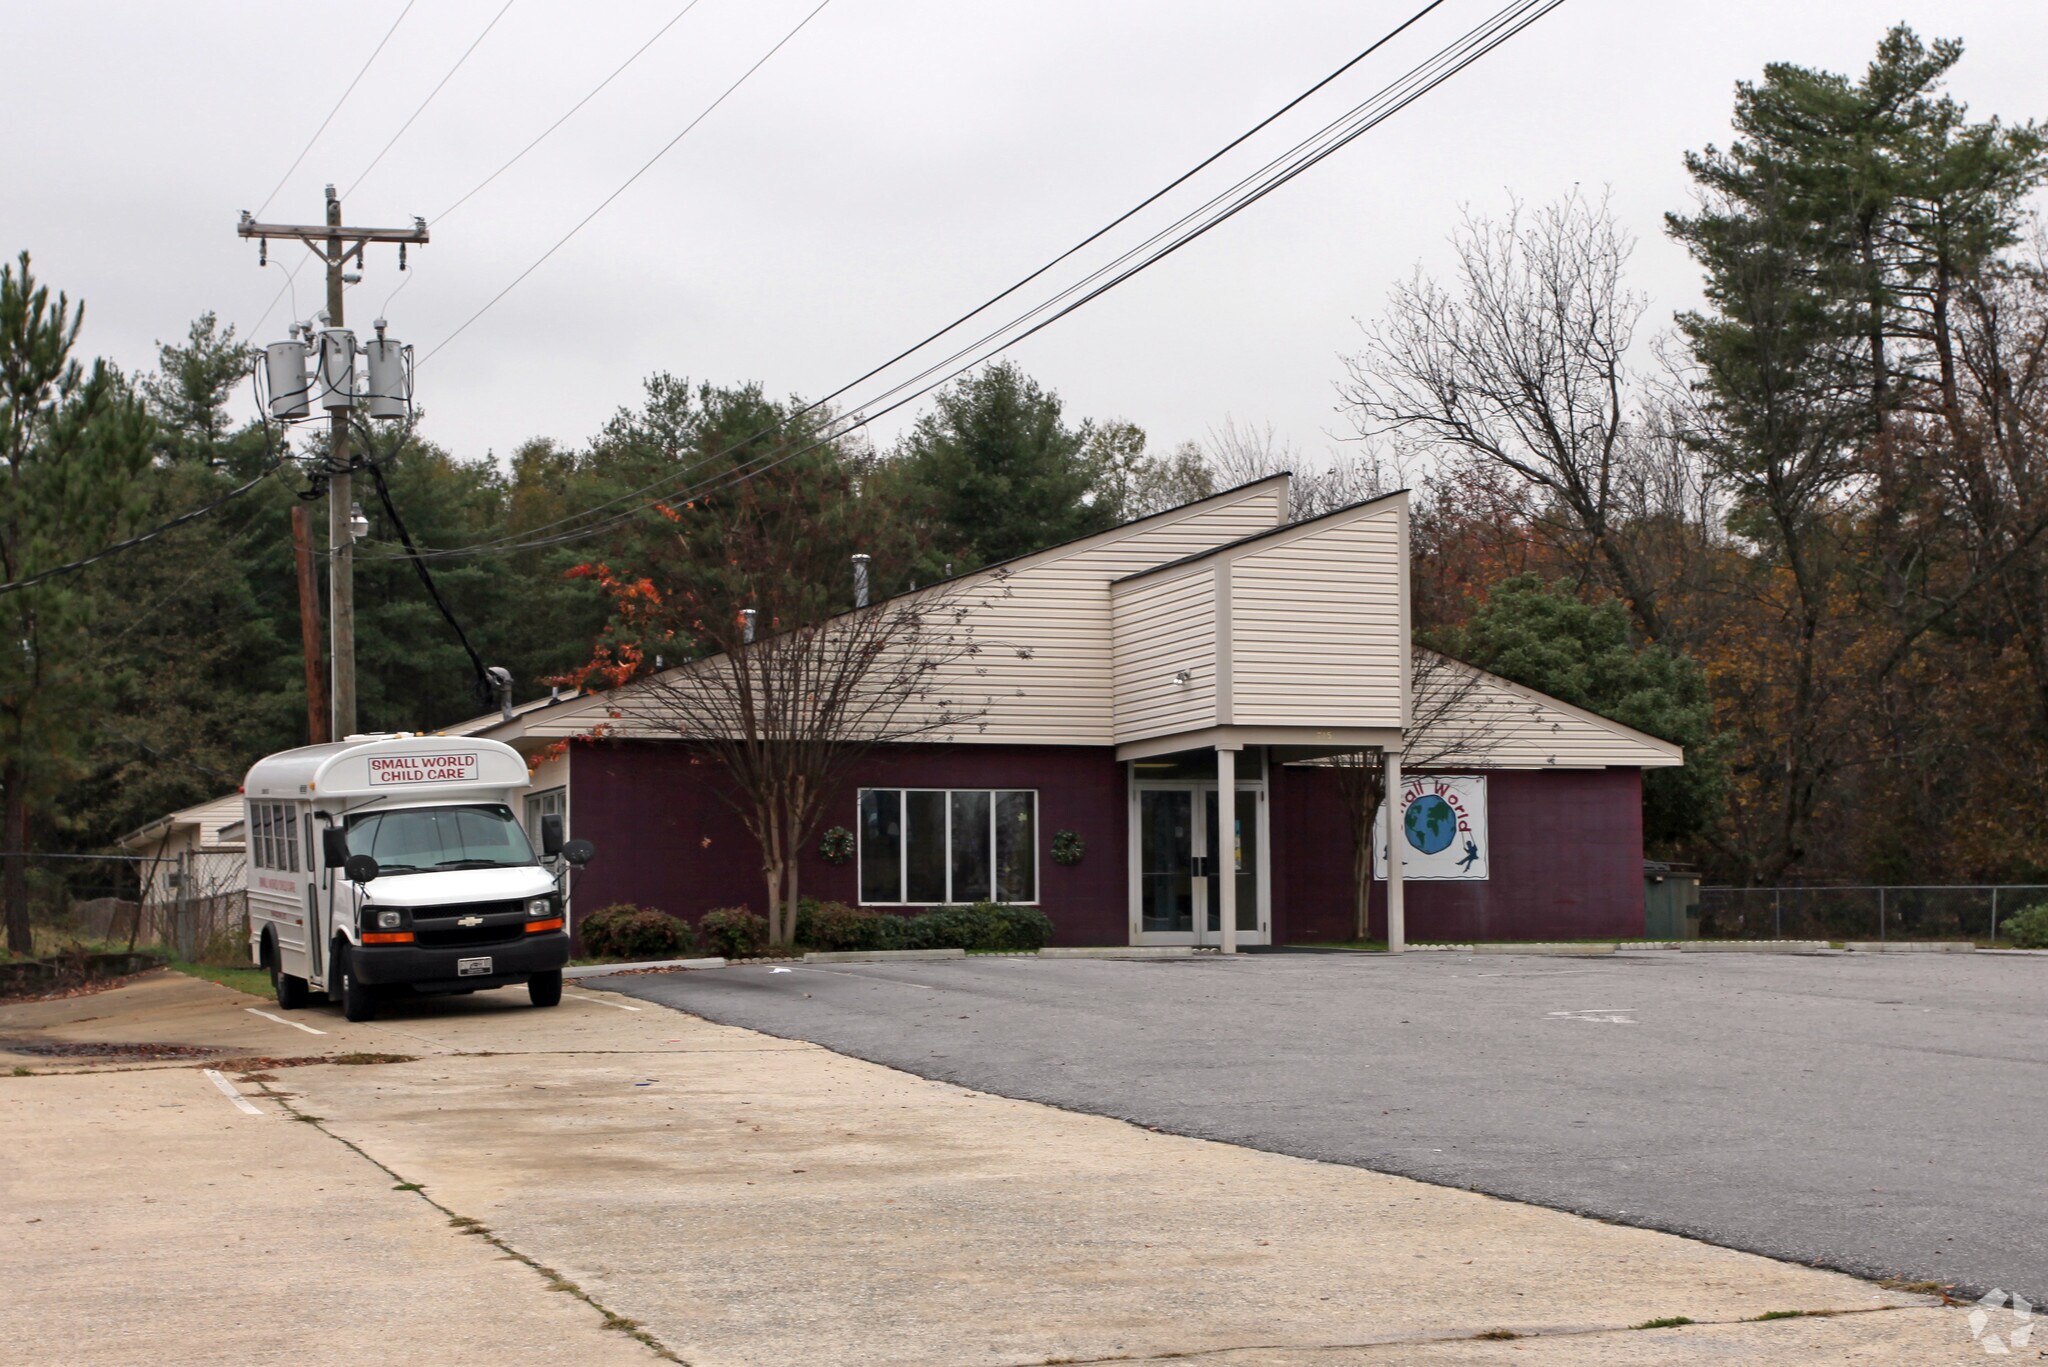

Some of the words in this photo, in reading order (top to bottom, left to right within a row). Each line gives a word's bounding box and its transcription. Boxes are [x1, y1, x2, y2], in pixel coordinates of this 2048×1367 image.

[371, 758, 419, 770] SMALL
[421, 755, 475, 768] WORLD
[381, 769, 424, 782] CHILD
[427, 768, 466, 780] CARE
[1434, 780, 1472, 832] World
